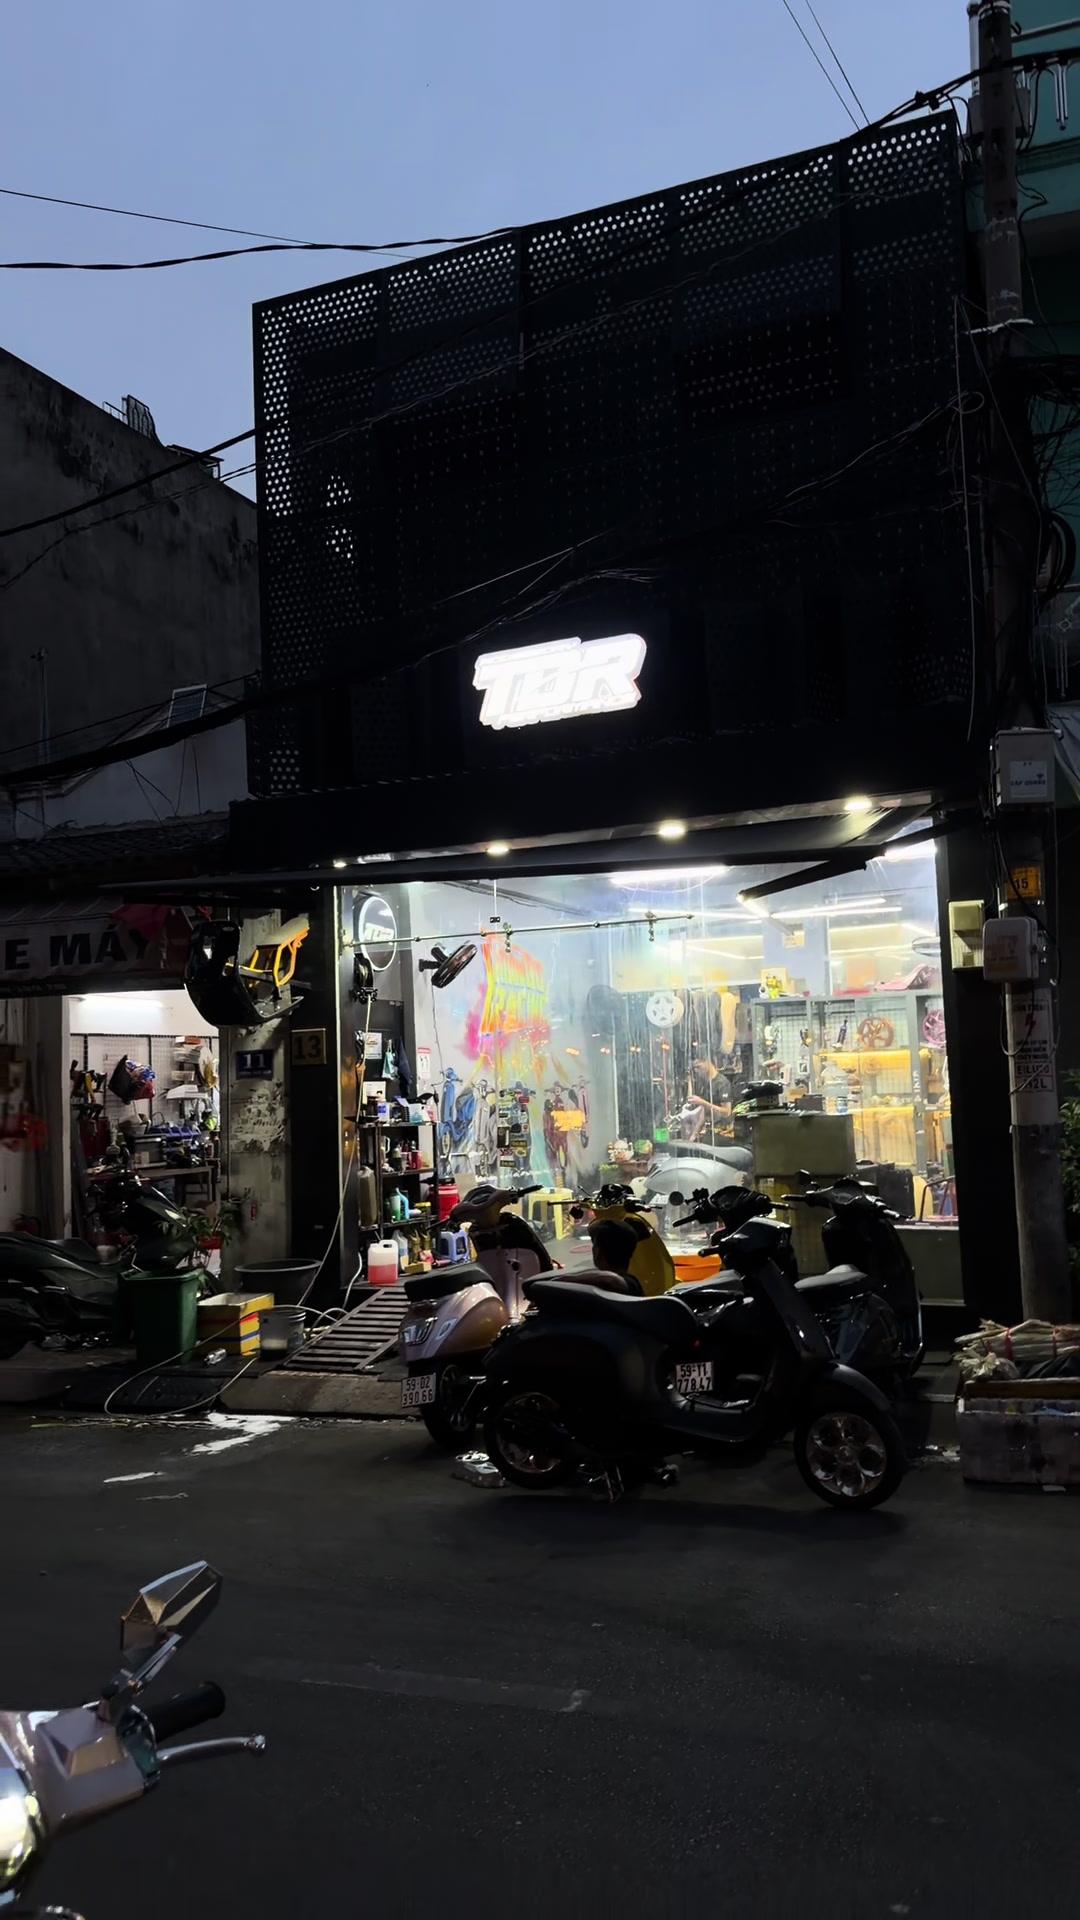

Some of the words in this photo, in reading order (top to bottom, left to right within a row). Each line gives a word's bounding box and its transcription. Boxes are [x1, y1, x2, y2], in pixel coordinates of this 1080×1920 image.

[5, 939, 29, 970] E
[49, 924, 148, 967] MÁY
[293, 1035, 322, 1060] 13
[242, 1052, 267, 1070] 11
